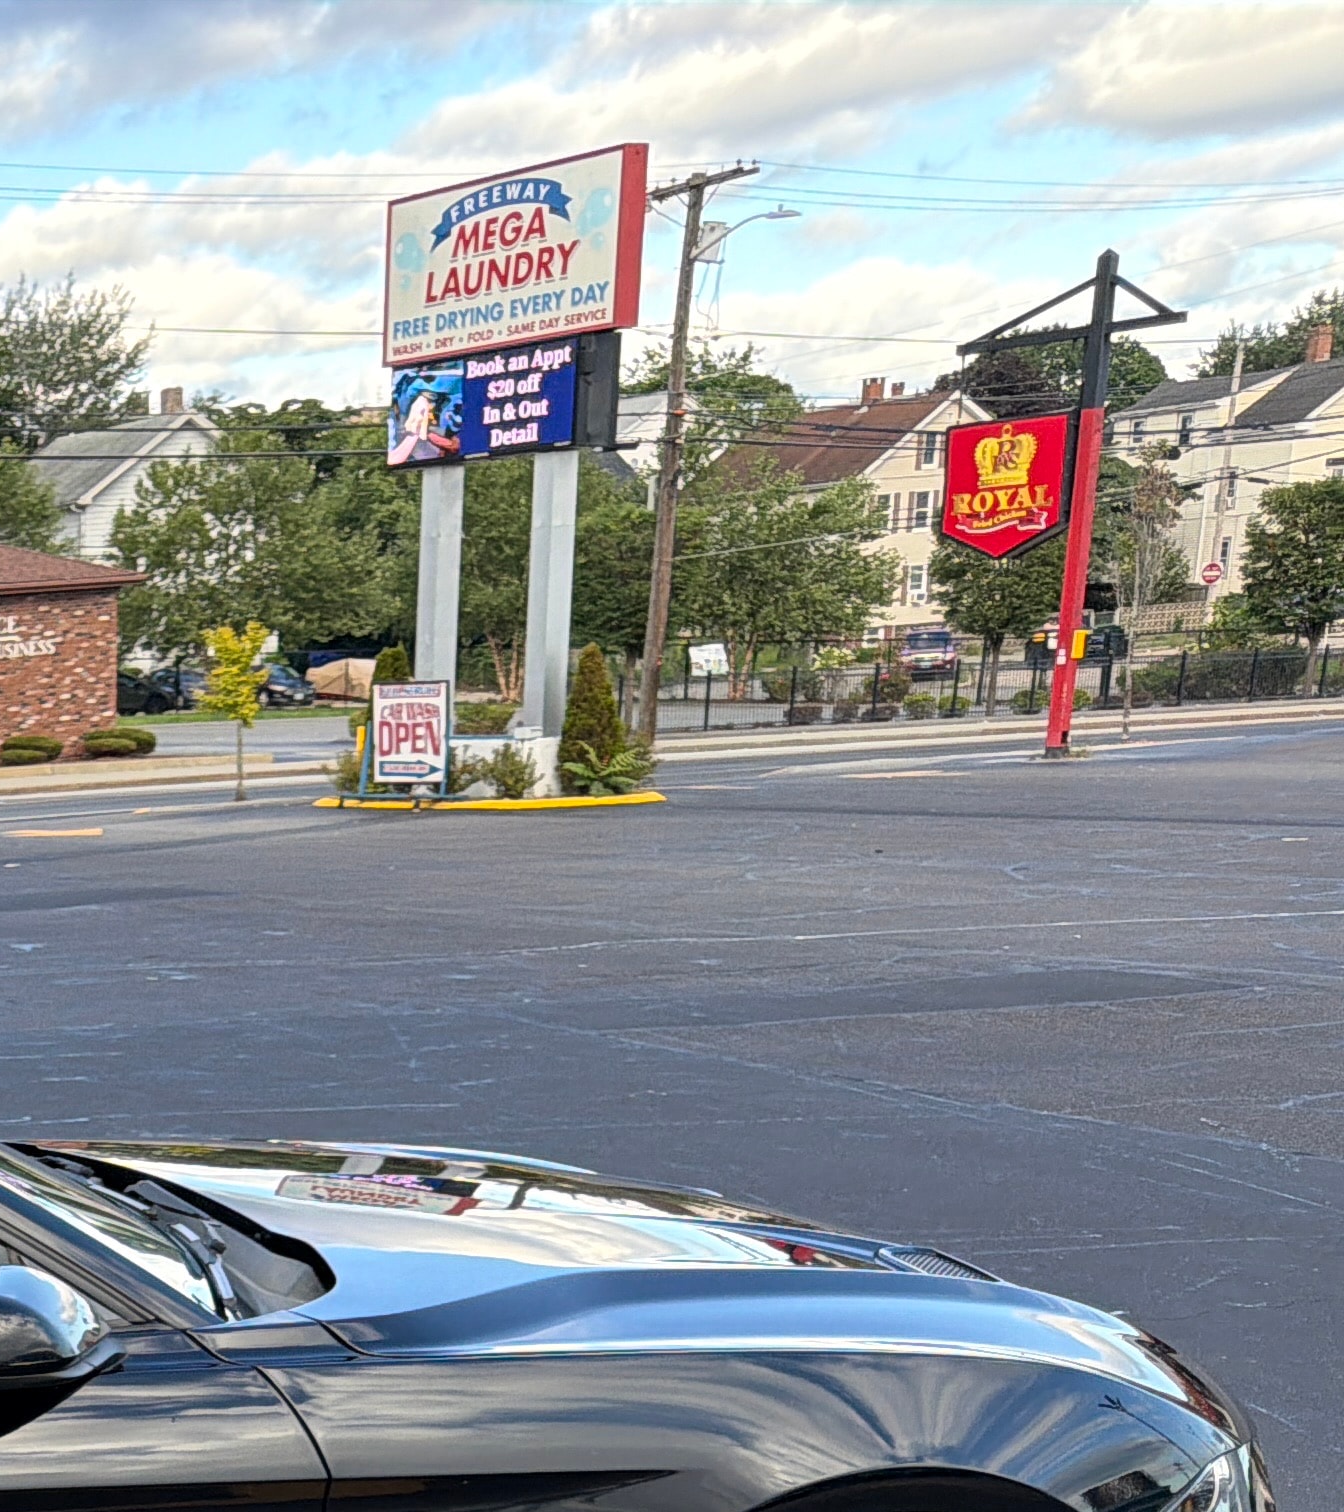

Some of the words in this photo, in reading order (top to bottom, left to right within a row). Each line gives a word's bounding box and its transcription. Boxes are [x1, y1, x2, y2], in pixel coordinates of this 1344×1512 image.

[450, 183, 552, 222] FREEWAY
[450, 206, 547, 259] MEGA
[424, 239, 580, 306] LAUNDRY
[392, 316, 430, 340] FREE
[435, 301, 505, 334] DRYING
[509, 290, 565, 318] EVERY
[570, 281, 610, 308] DAY
[434, 335, 455, 350] DRY
[466, 328, 495, 344] FOLD
[506, 319, 536, 337] SAME
[538, 316, 561, 331] DAY
[563, 308, 608, 327] SERVICE
[466, 355, 506, 379] Book
[507, 355, 529, 372] an
[530, 345, 572, 371] Appt
[486, 378, 515, 400] $20
[516, 373, 543, 395] off
[482, 406, 501, 425] In
[502, 402, 517, 421] &
[518, 398, 549, 419] Out
[489, 422, 539, 448] Detail
[951, 484, 1054, 516] ROYAL
[378, 719, 442, 757] OPEN
